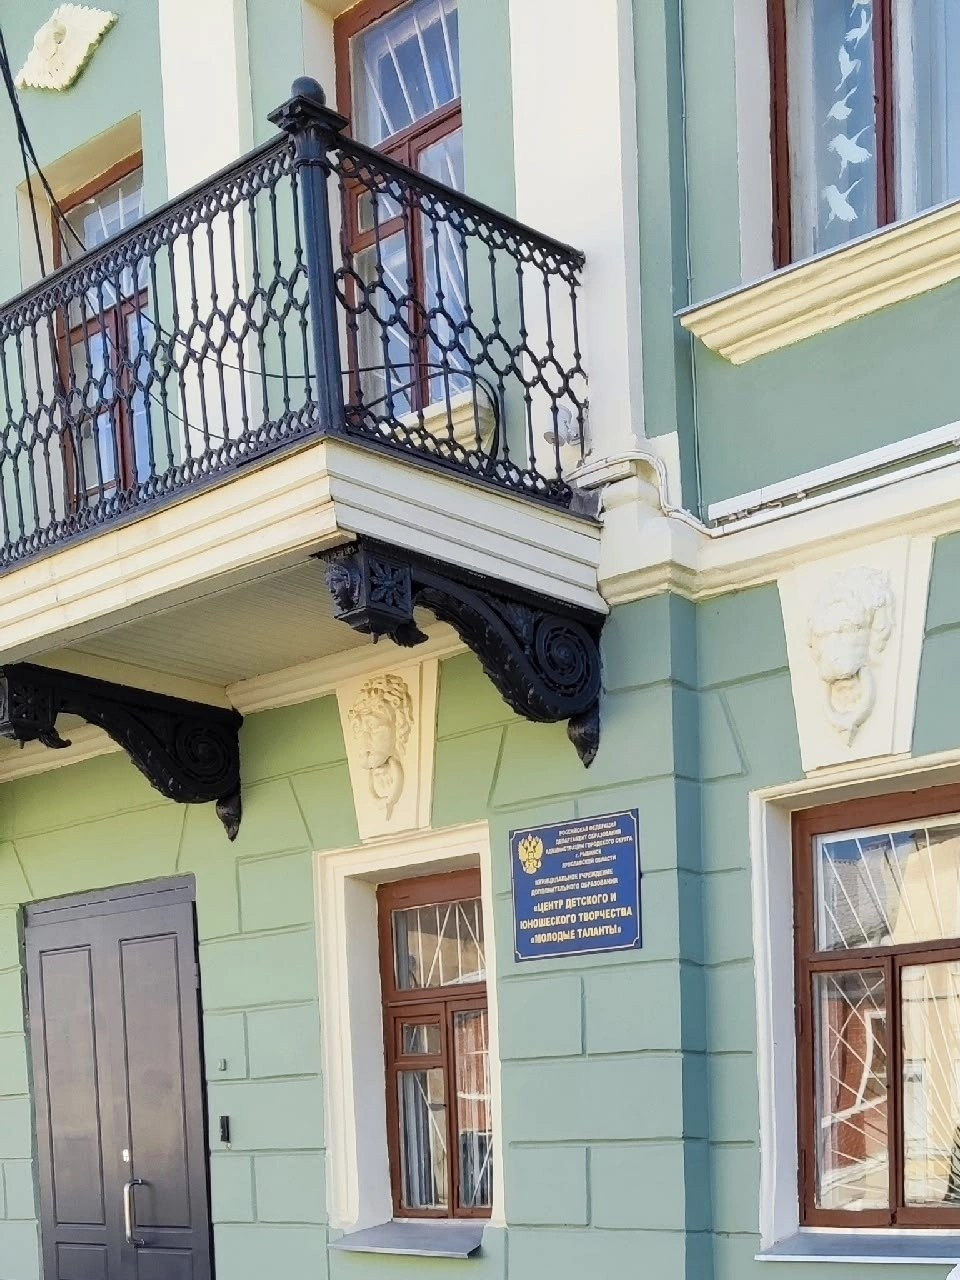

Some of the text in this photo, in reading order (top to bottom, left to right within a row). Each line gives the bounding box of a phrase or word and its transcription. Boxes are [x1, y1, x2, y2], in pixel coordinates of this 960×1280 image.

[534, 892, 617, 913] «ЦЕНТР ДЕТСКОГО И
[520, 906, 632, 929] ЮНОШЕСКОГО ТВОРЧЕСТВА
[530, 924, 621, 943] «МОЛОДЫЕ ТАЛАНТЫ»
